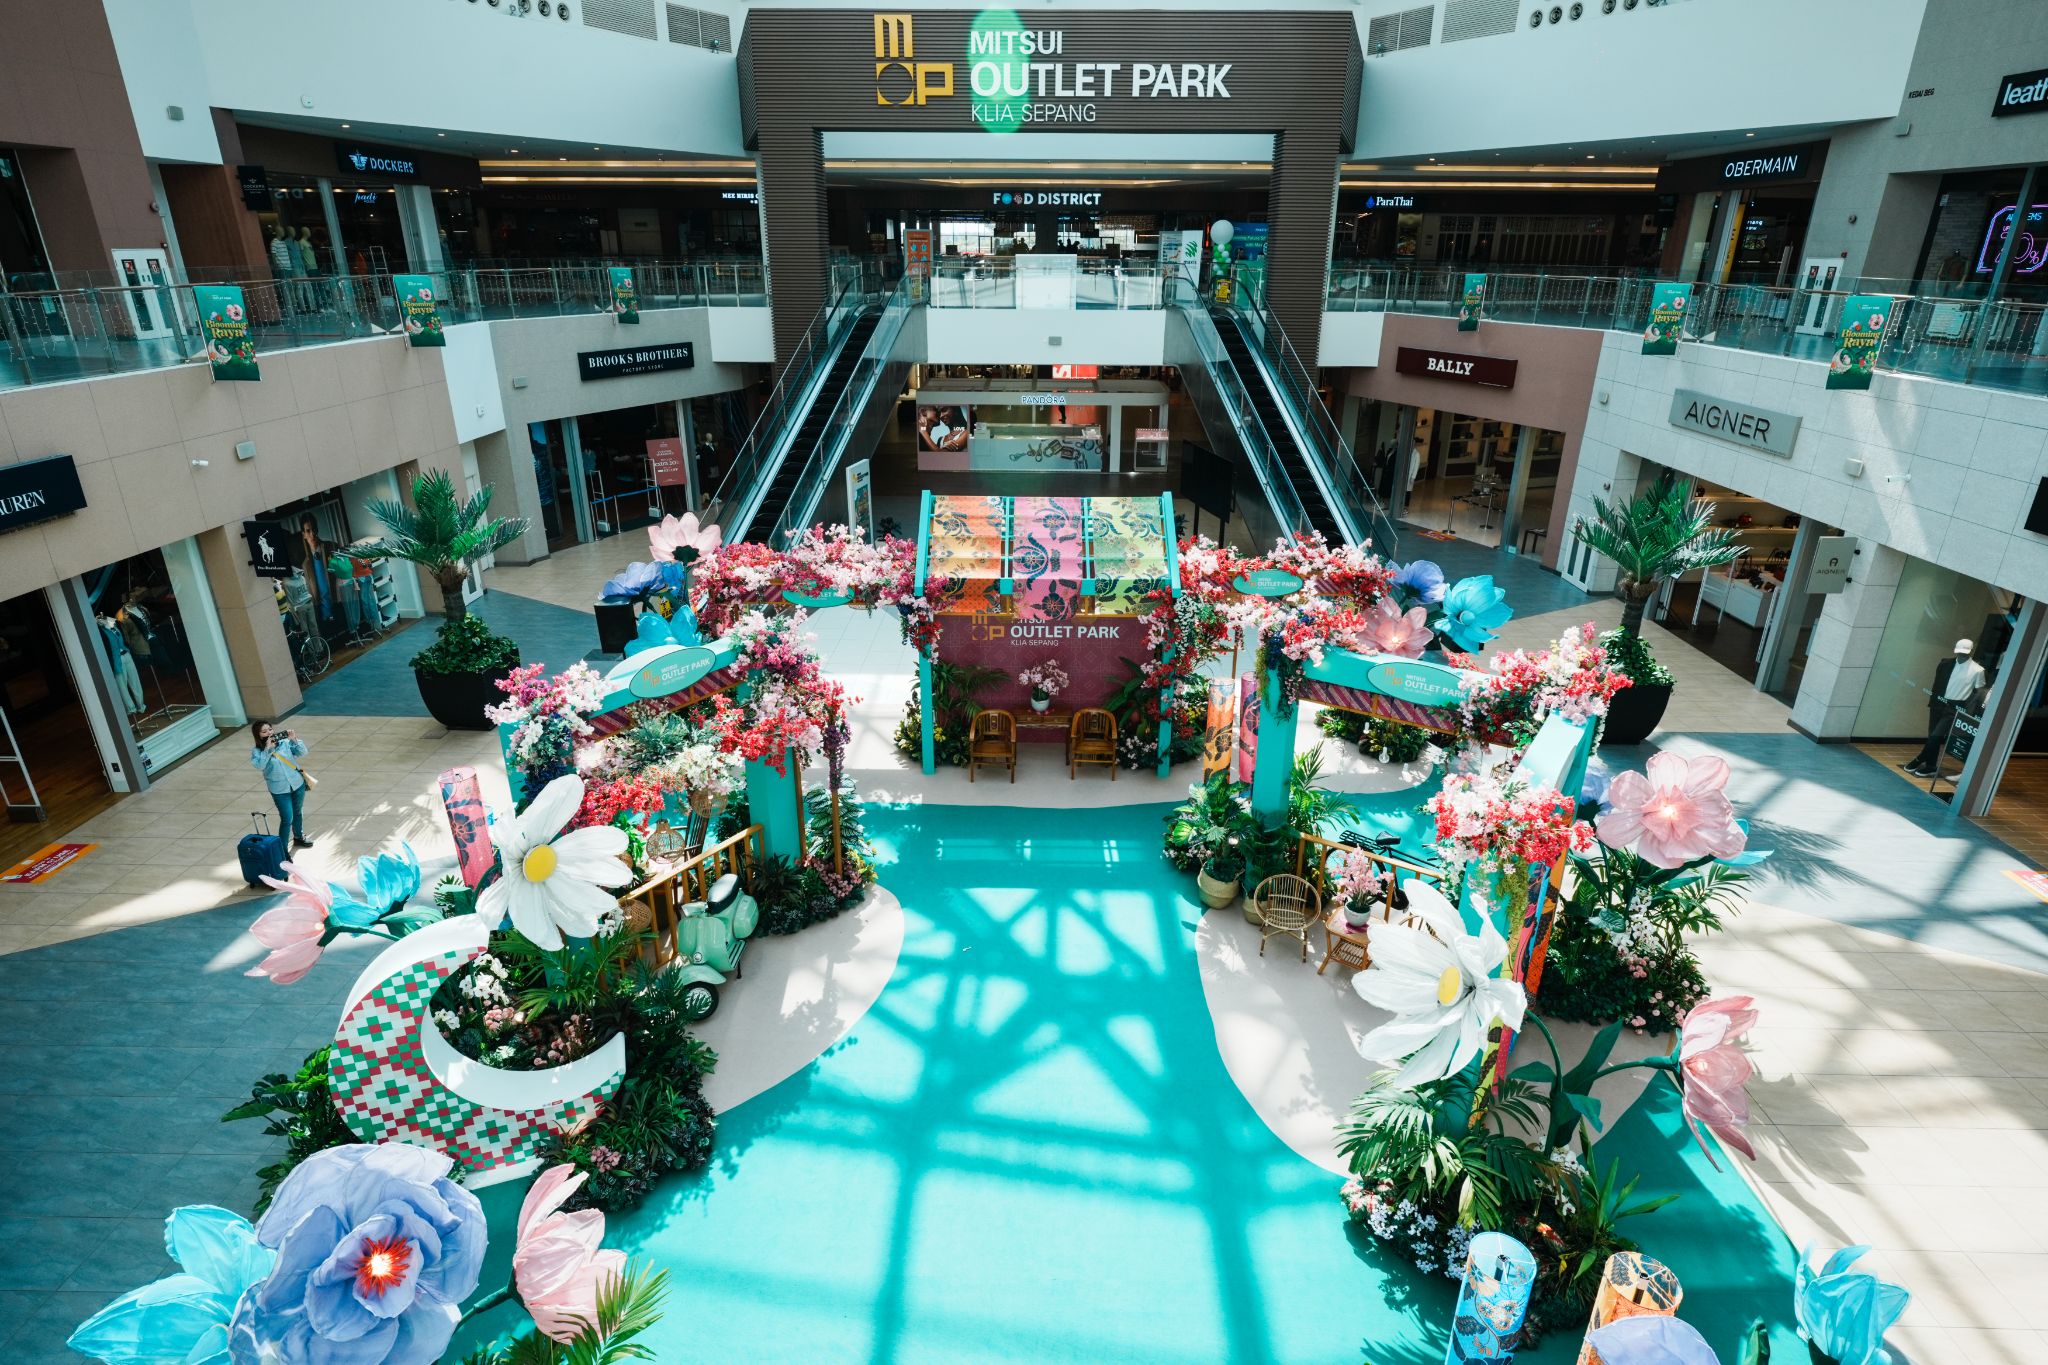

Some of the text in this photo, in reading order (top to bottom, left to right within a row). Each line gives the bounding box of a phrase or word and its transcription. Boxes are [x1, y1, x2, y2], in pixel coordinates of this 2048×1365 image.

[970, 30, 1063, 55] MITSUI
[970, 61, 1233, 98] OUTLET PARK
[971, 103, 1097, 122] KLIA SEPANG
[369, 157, 414, 174] DOCKERS
[1724, 155, 1798, 178] OBERMAIN
[1038, 193, 1101, 205] DISTRICT
[1375, 196, 1414, 207] ParaThai
[408, 307, 433, 315] Raya
[1654, 315, 1679, 323] Raya
[205, 319, 248, 330] Blooming
[211, 327, 244, 339] Raya
[1841, 329, 1882, 340] Blooming
[1843, 337, 1875, 348] Raya
[587, 347, 689, 369] BROOKS BROTHERS
[1427, 357, 1475, 376] BALLY
[1021, 394, 1066, 405] PANDORA
[1684, 400, 1771, 444] AIGNER
[0, 489, 46, 516] UREN
[1010, 625, 1074, 638] OUTLET
[1077, 626, 1120, 639] PARK
[1028, 639, 1059, 647] SEPANG
[661, 666, 690, 681] OUTLET
[691, 658, 711, 671] PARK
[1404, 679, 1440, 693] OUTLET
[1441, 687, 1468, 699] PARK
[1955, 718, 1979, 737] BOSS
